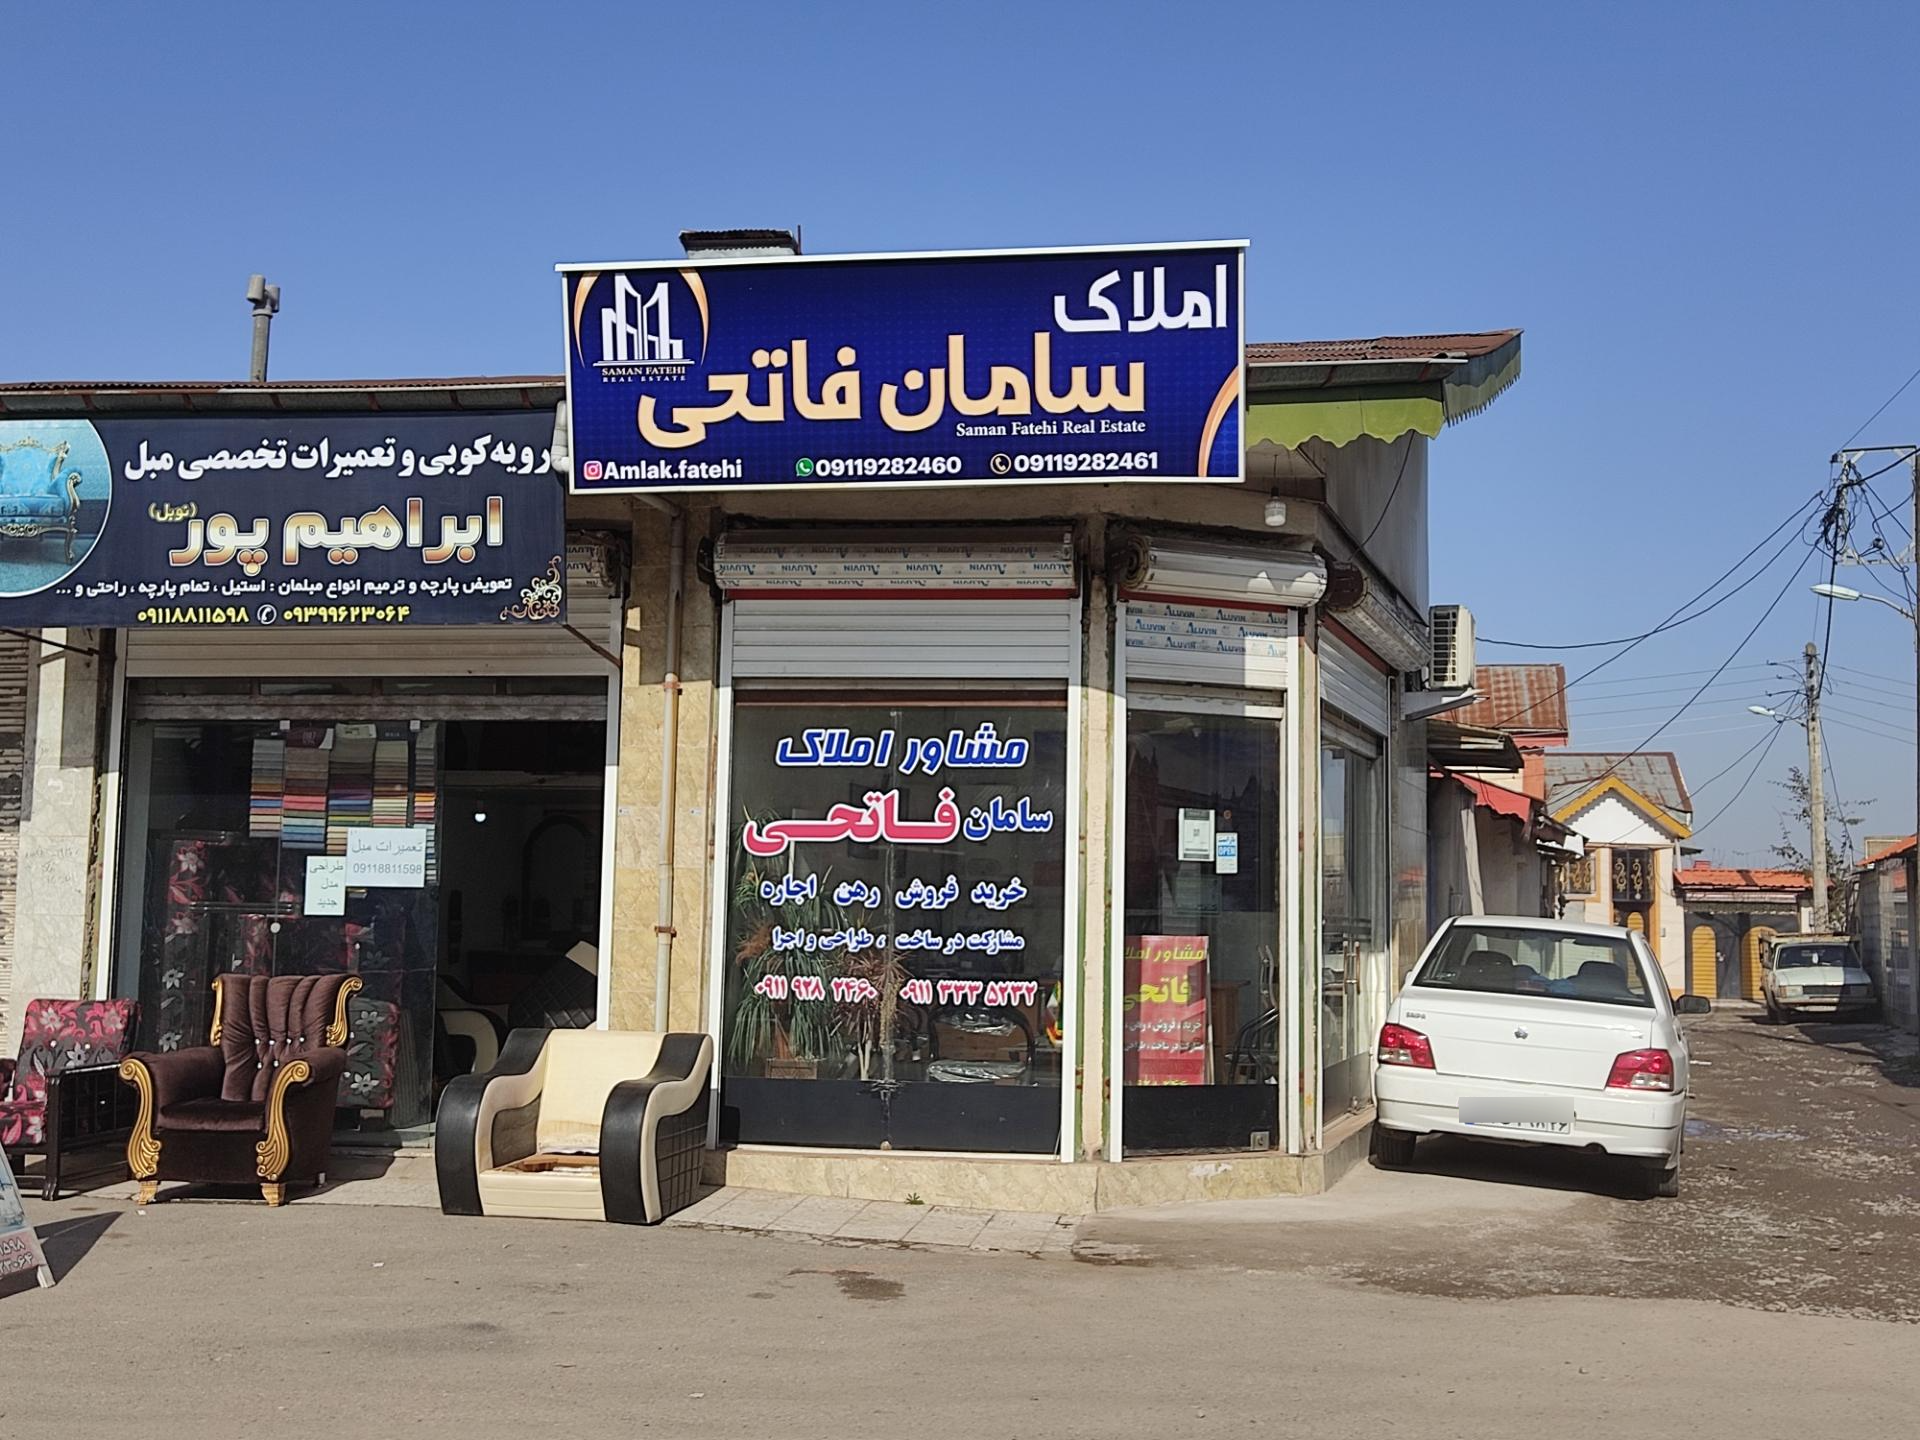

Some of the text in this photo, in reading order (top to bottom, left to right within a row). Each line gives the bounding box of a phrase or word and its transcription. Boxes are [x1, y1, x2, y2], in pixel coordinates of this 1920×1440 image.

[1053, 263, 1228, 334] املاک
[601, 366, 686, 377] SAMAN FATEHI
[637, 331, 1146, 449] سامان فاتحی
[956, 419, 1146, 437] Saman Fatehi Real Estate
[124, 439, 174, 480] مبل
[178, 438, 288, 480] تخصصی
[291, 436, 396, 478] تعمیرات
[398, 449, 415, 477] و
[815, 456, 962, 477] 09119282460
[1013, 451, 1158, 473] 09119282461
[603, 458, 743, 480] Amlak.fatehi
[168, 495, 504, 577] ابراهیم پور
[75, 584, 83, 597] و
[86, 580, 126, 597] راحتی
[138, 581, 177, 599] پارچه
[179, 580, 210, 597] تمام
[221, 579, 265, 596] استیل
[277, 579, 323, 596] مبلمان
[326, 578, 360, 599] انواع
[364, 578, 405, 596] ترمیم
[408, 582, 416, 594] و
[420, 577, 459, 597] پارچه
[463, 578, 513, 594] تعویض
[137, 606, 250, 624] ۰۹۱۱۸۸۱۱۵۹۸
[775, 723, 1029, 775] مشاور املاک
[742, 786, 1053, 856] سامان فاتحی
[351, 838, 423, 856] تعمیرات مبل
[352, 863, 422, 875] 09118811598
[761, 873, 1027, 910] خرید فروش رهن اجاره
[772, 925, 805, 951] اجرا
[804, 933, 816, 951] و
[818, 926, 874, 952] طراحی
[895, 929, 943, 950] ساخت
[942, 932, 965, 955] در
[966, 929, 1025, 955] مشارکت
[1124, 944, 1205, 962] مشاور املا
[755, 974, 789, 1000] ۰۹۱۱
[900, 979, 933, 1004] ۰۹۱۱
